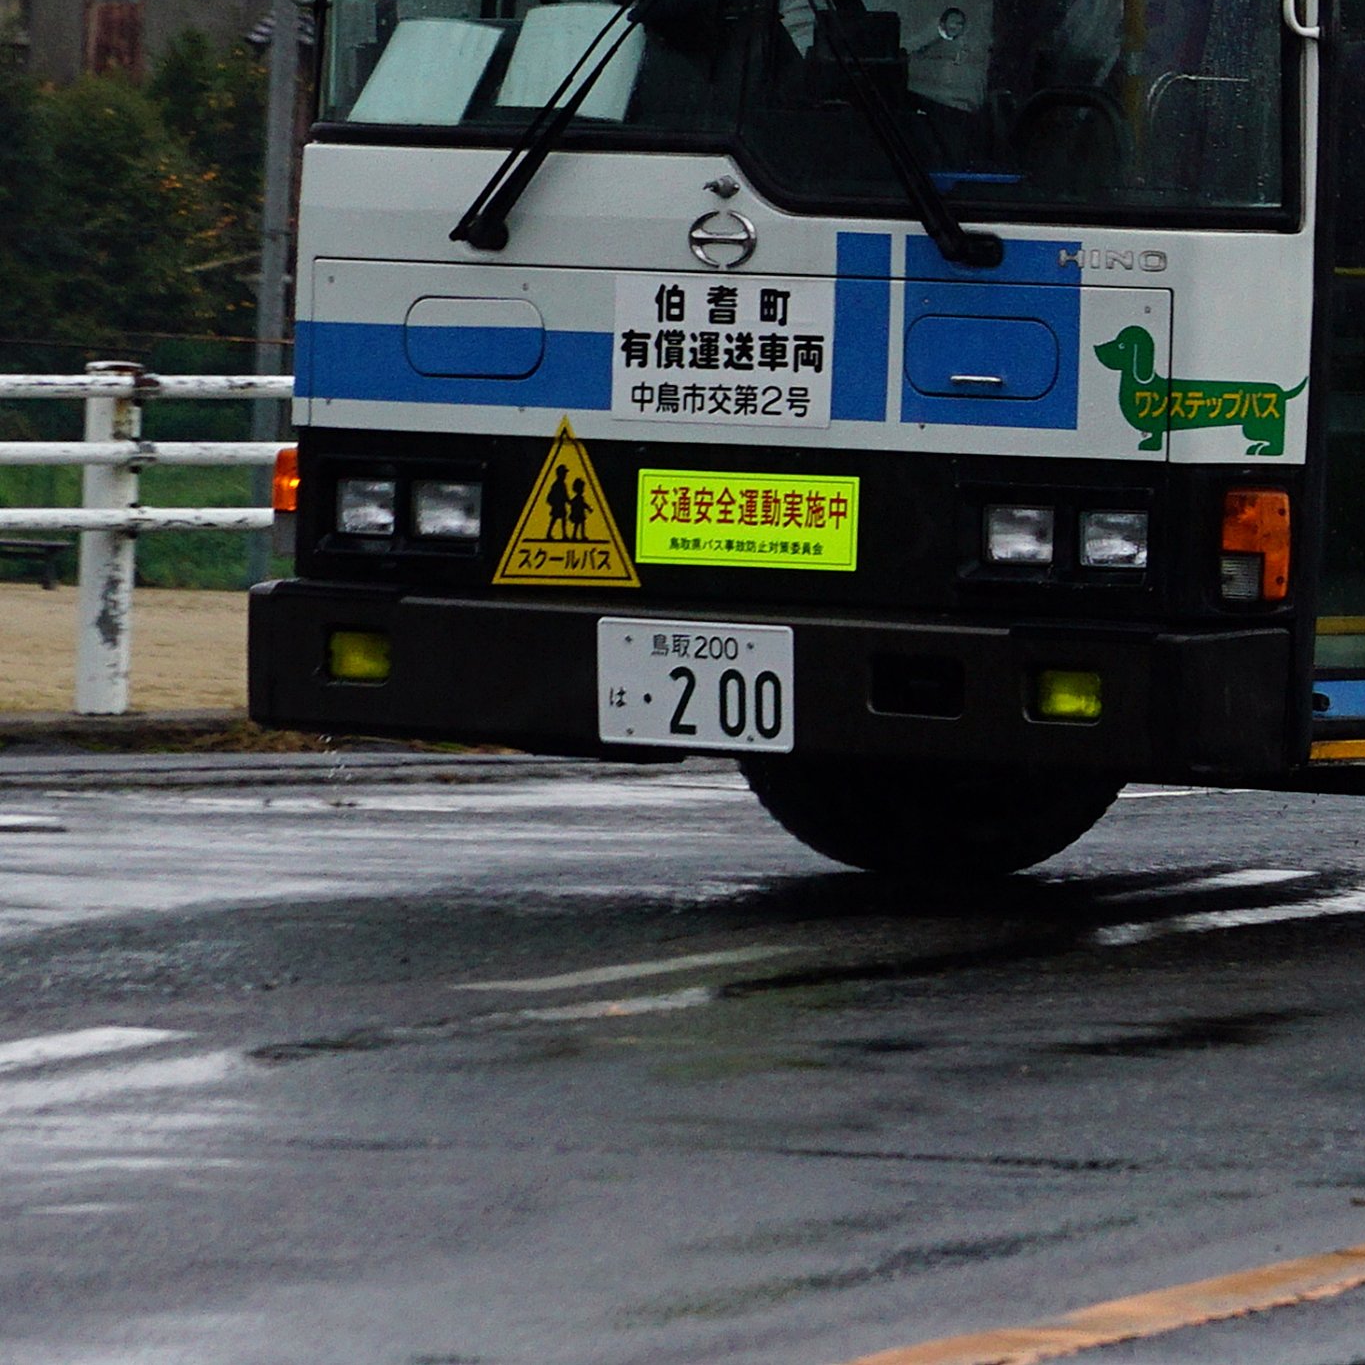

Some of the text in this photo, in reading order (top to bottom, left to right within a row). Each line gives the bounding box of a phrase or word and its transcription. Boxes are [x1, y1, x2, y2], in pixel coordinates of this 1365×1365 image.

[1058, 248, 1168, 272] HINO
[655, 283, 791, 327] 伯耆町
[620, 329, 825, 374] 有償運送車両
[631, 381, 811, 418] 中鳥市交第2号
[1134, 389, 1281, 420] ワンステップバス
[649, 484, 849, 530] 交通安全運動実施中
[518, 547, 612, 571] スクールバス
[609, 686, 628, 708] は
